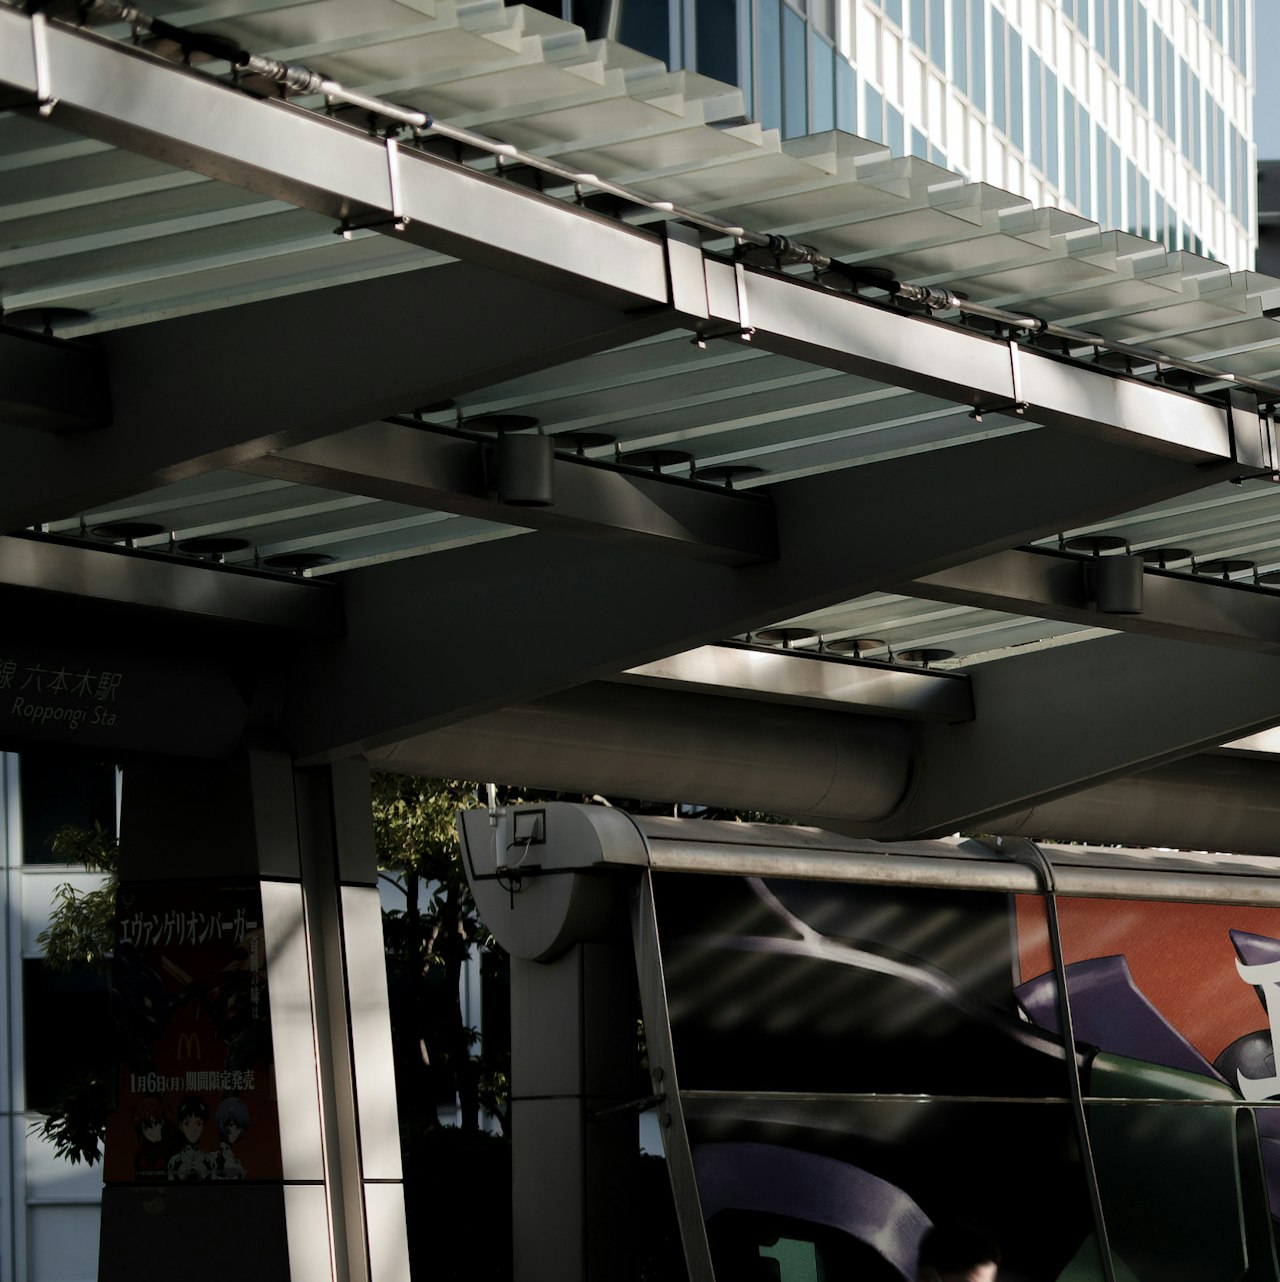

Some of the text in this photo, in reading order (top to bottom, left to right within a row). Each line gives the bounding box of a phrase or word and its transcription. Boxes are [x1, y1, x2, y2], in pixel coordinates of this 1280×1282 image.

[11, 696, 120, 730] Roppongi Sta.
[120, 907, 257, 948] エヴァンゲリオンバーガー
